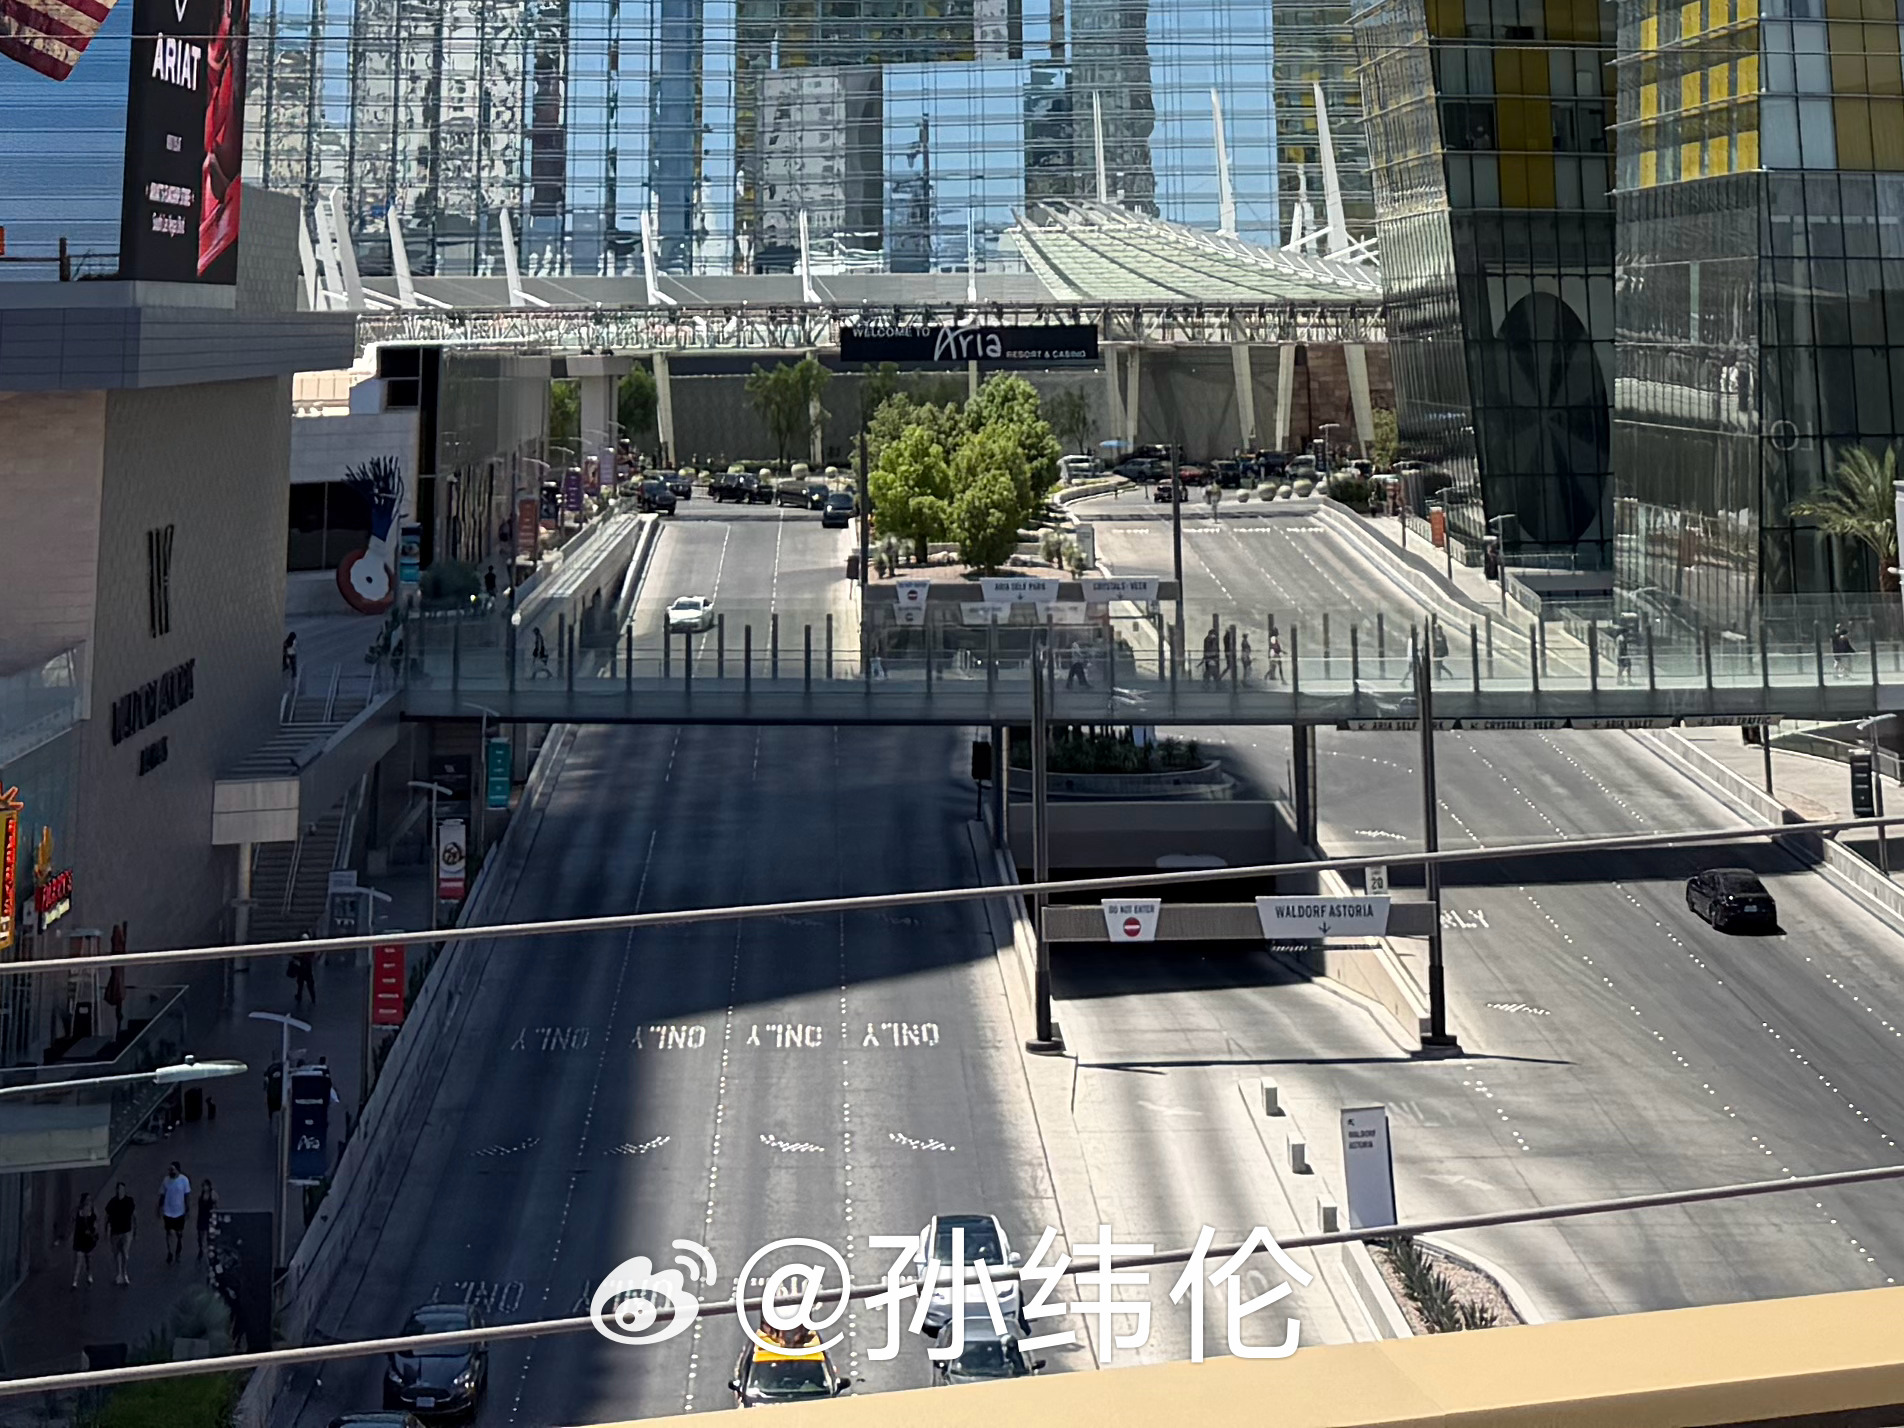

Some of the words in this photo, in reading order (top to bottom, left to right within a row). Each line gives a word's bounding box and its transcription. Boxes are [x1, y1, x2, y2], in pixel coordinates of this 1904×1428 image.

[152, 33, 201, 91] ARIAT
[852, 326, 912, 338] WELCOME
[916, 327, 930, 337] TO
[933, 325, 1002, 361] Aria
[1006, 350, 1042, 358] RESORT
[1052, 350, 1086, 358] CASINO
[1275, 905, 1326, 918] WALDORF
[1329, 904, 1374, 918] ASTORIA
[862, 1022, 940, 1047] ONLY
